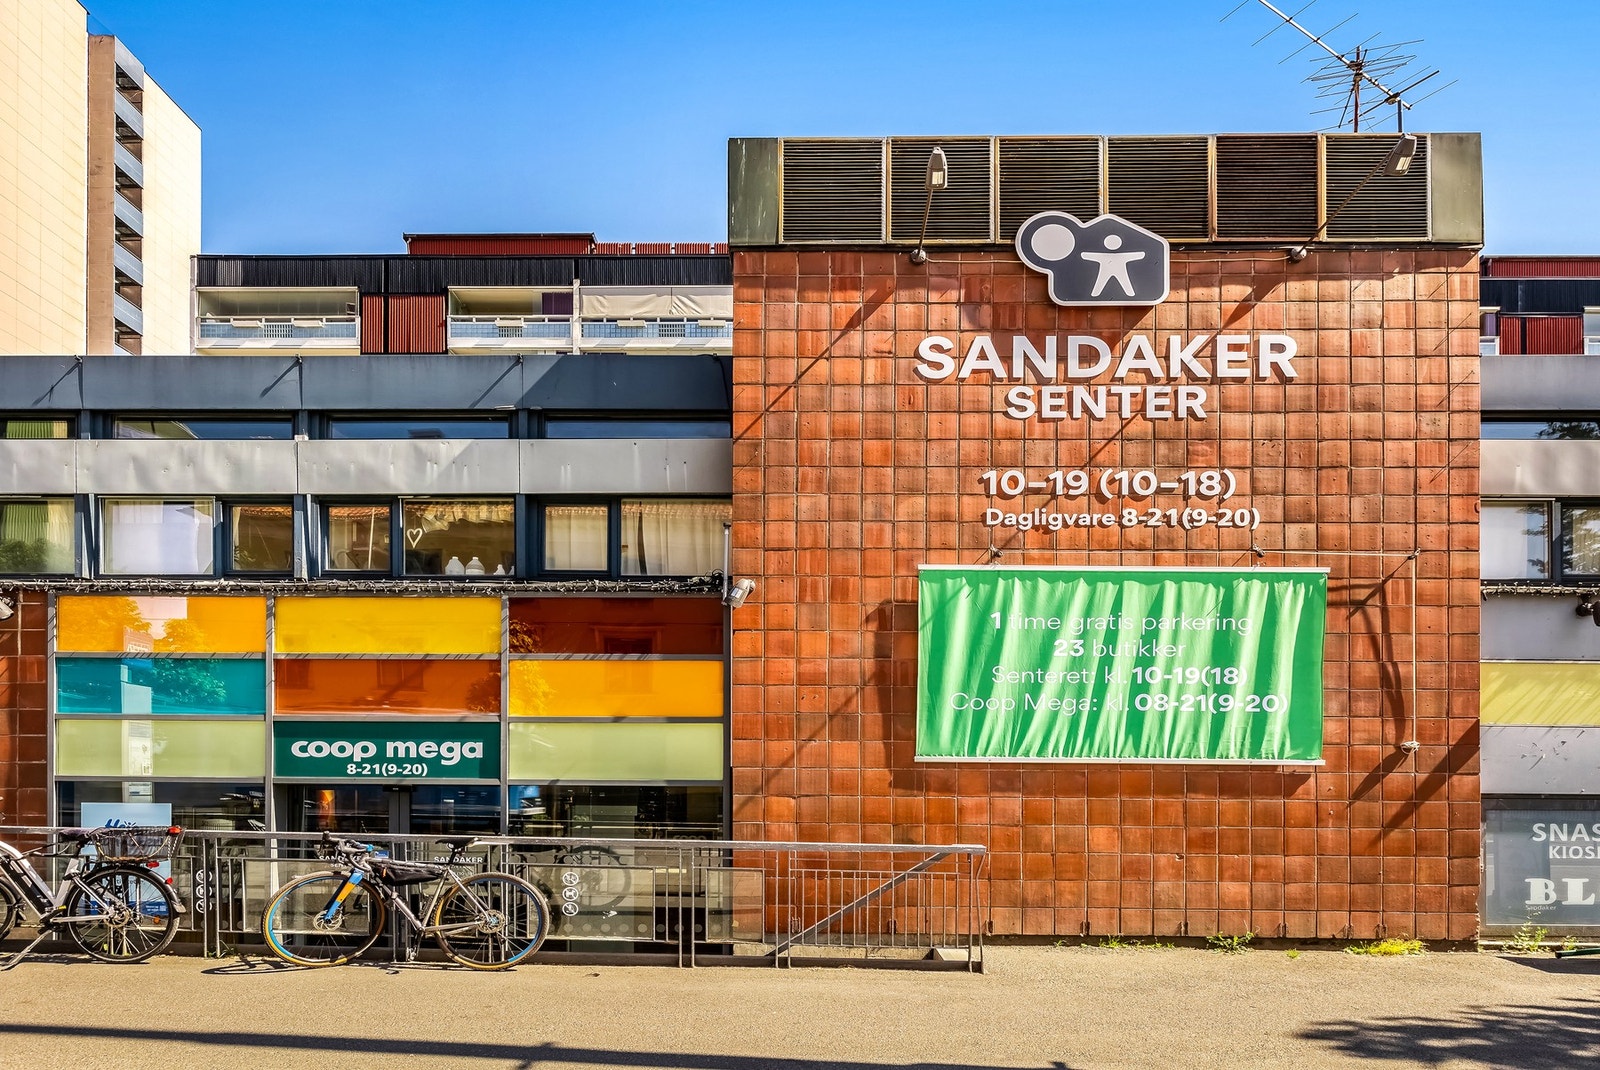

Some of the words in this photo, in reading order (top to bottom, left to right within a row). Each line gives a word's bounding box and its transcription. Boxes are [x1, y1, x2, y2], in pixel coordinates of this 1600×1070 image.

[916, 335, 1299, 380] SANDAKER
[1007, 385, 1208, 419] SENTER
[985, 508, 1116, 531] Dagligvare
[1121, 507, 1262, 530] 8-21(9-20)
[990, 612, 1002, 629] 1
[1009, 612, 1061, 630] time
[1069, 613, 1134, 636] gratis
[1141, 612, 1253, 636] parkering
[1053, 639, 1085, 657] 23
[1093, 639, 1187, 658] butikker
[991, 665, 1096, 685] Senteret:
[1104, 665, 1129, 685] kl.
[1131, 666, 1248, 687] 10-19(18)
[949, 693, 1015, 712] Coop
[1024, 694, 1098, 714] Mega:
[1106, 694, 1131, 713] kl.
[1134, 694, 1289, 714] 08-21(9-20)
[291, 740, 377, 762] coop
[386, 740, 483, 765] mega
[346, 763, 428, 776] 8-21(9-20)
[1549, 845, 1600, 859] KIOS
[1524, 878, 1596, 905] BL
